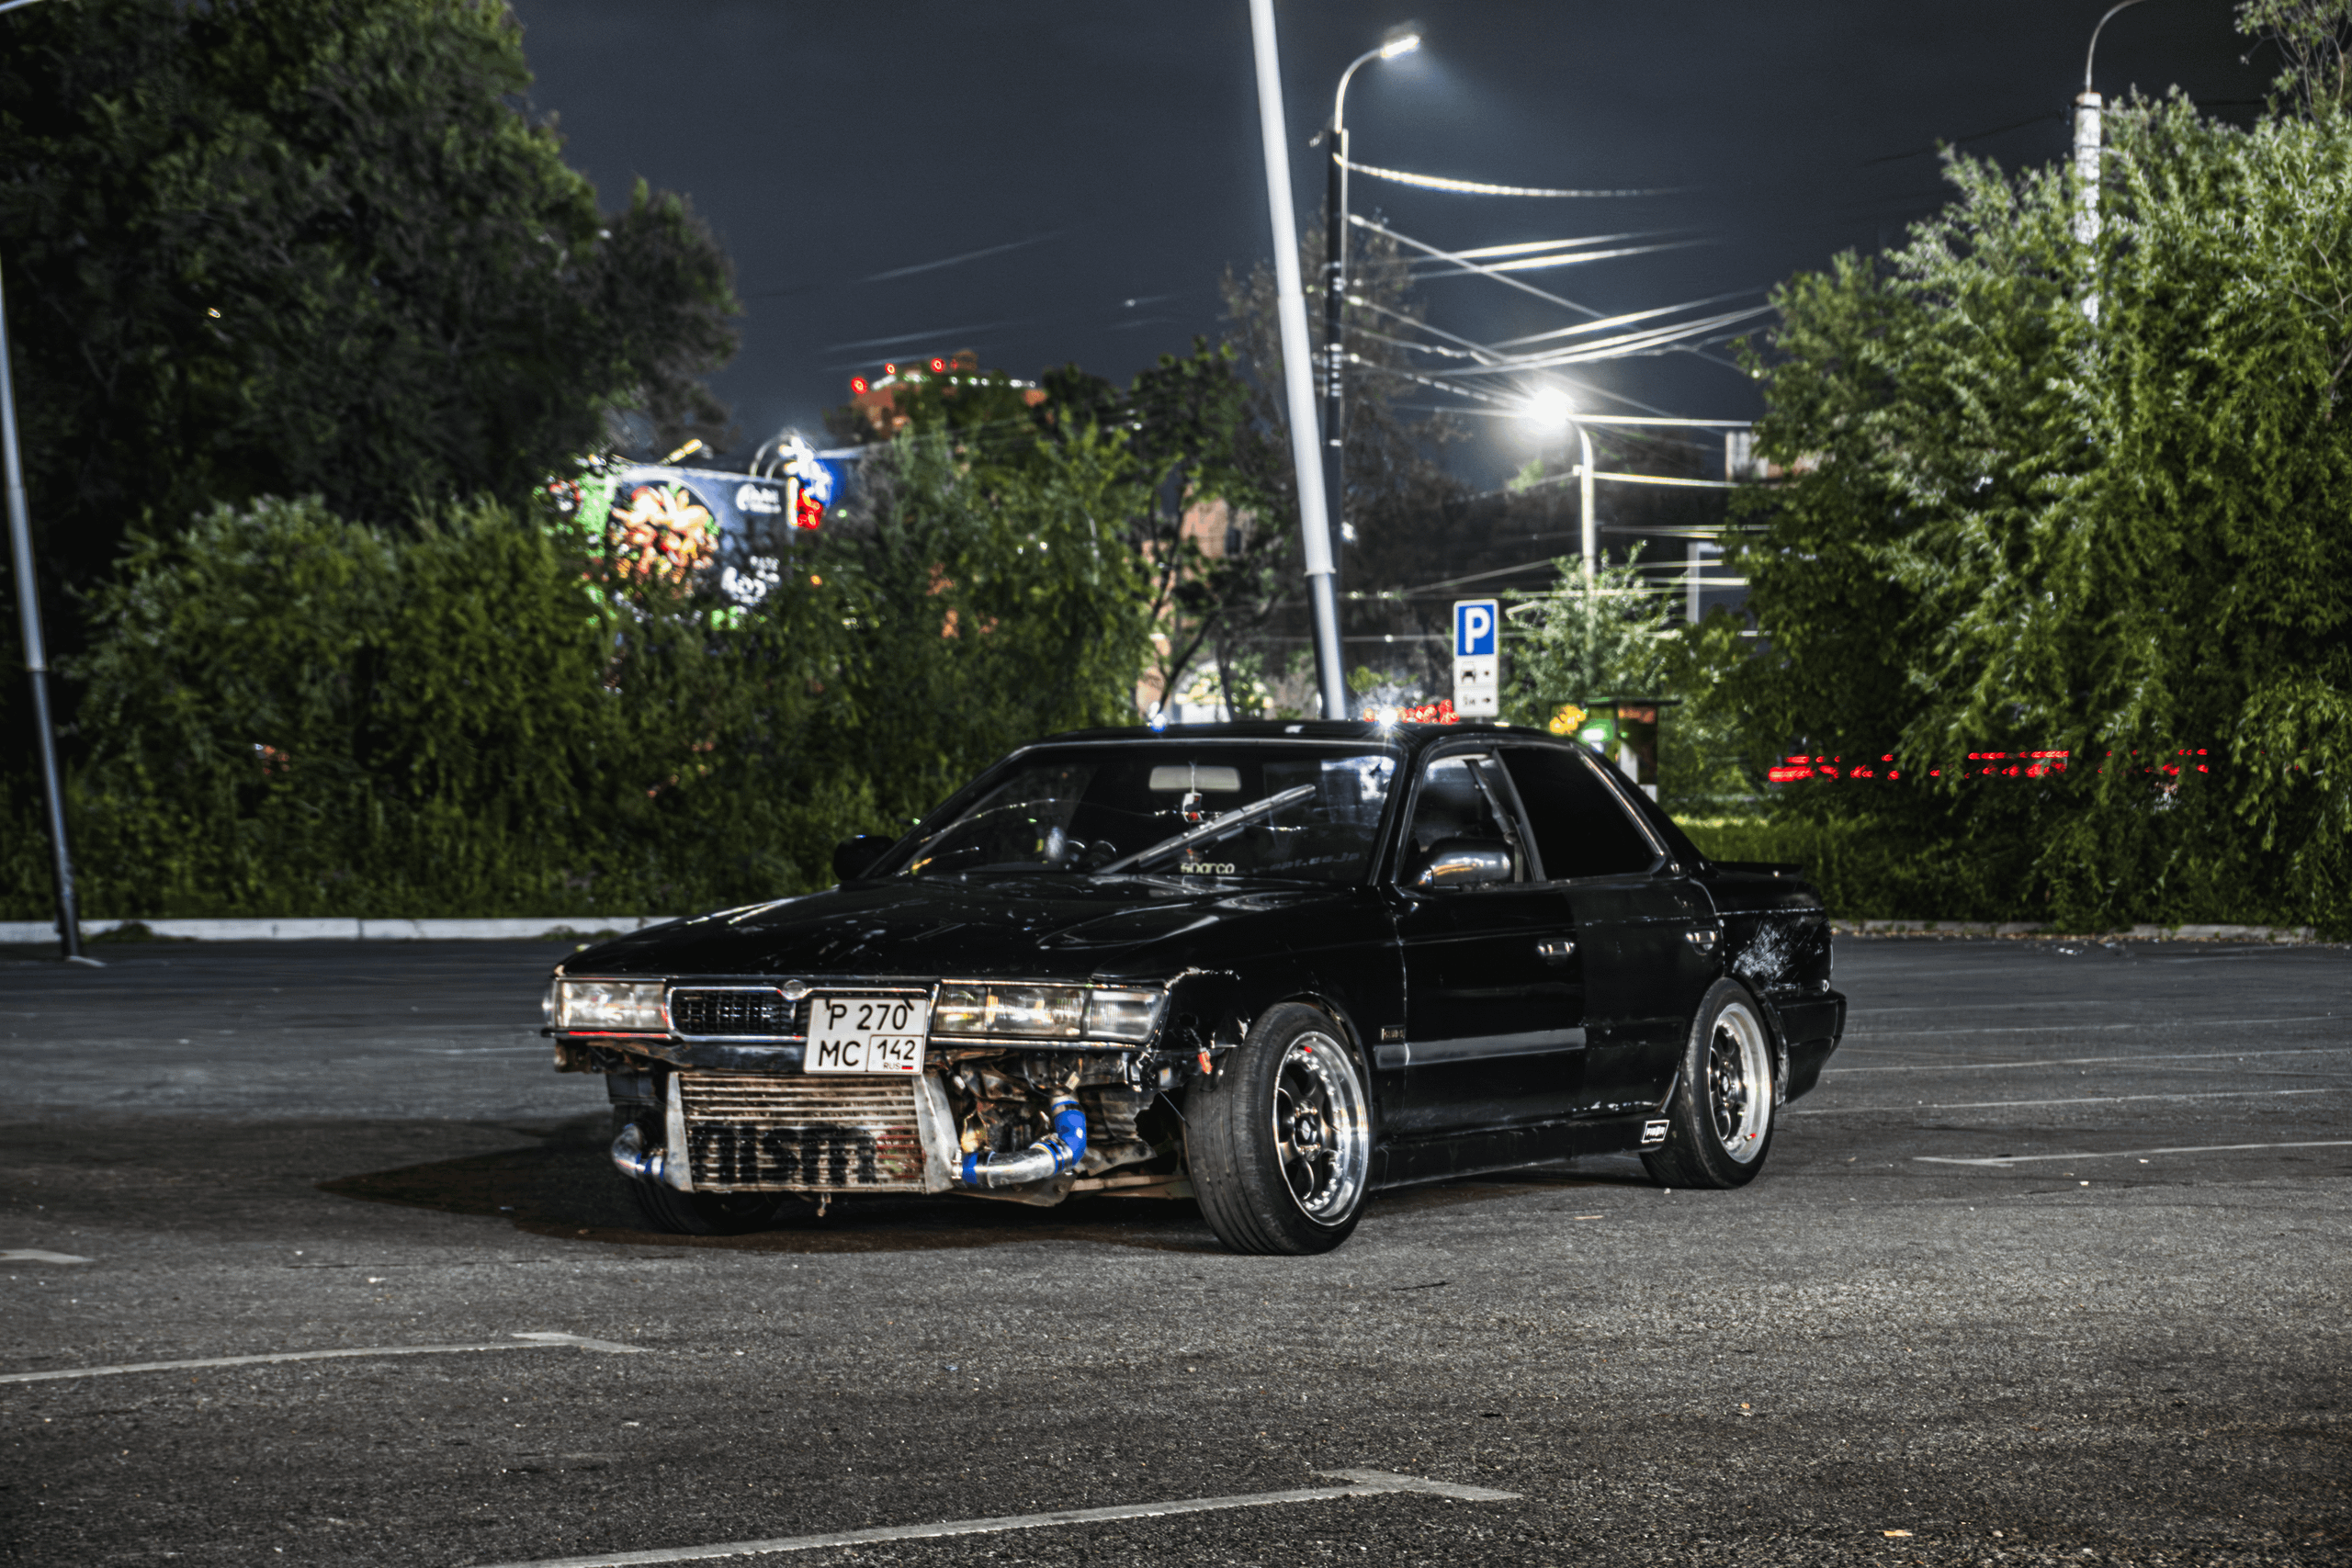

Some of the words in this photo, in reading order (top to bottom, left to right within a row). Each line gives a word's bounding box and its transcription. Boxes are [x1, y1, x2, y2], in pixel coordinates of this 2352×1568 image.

[1464, 606, 1490, 654] P
[829, 1003, 847, 1030] P
[856, 1003, 908, 1030] 270
[819, 1040, 861, 1066] MC
[877, 1039, 916, 1060] 142
